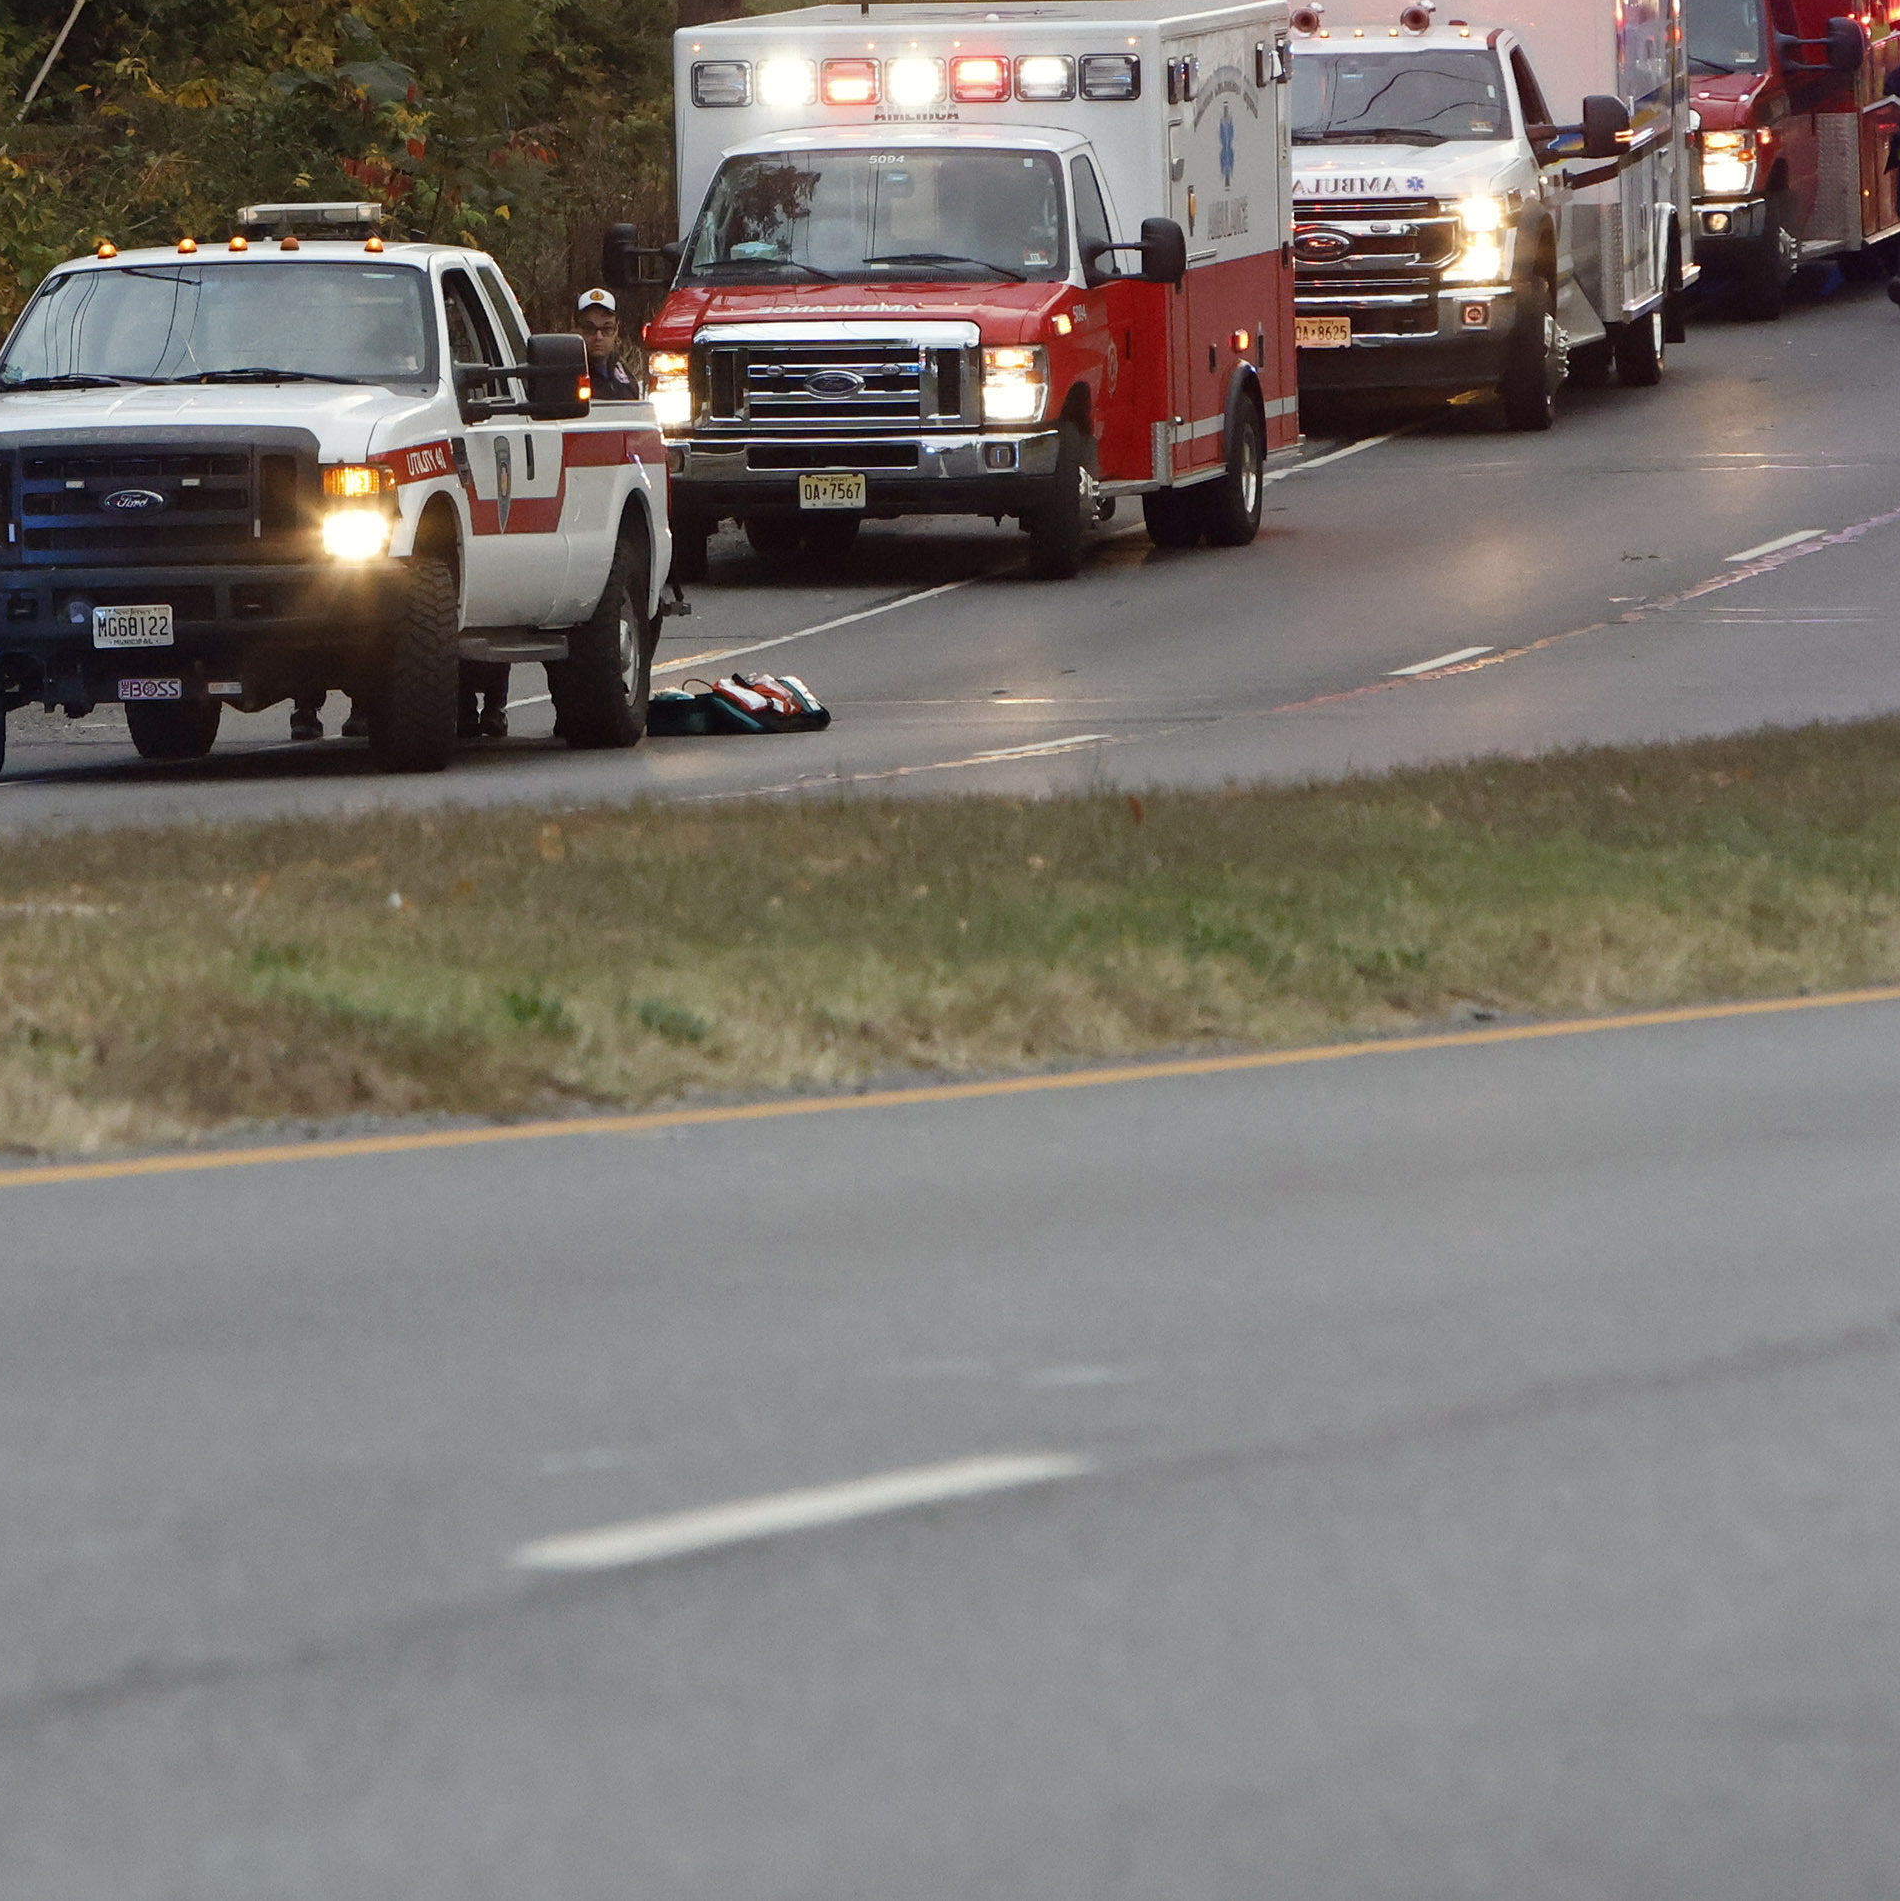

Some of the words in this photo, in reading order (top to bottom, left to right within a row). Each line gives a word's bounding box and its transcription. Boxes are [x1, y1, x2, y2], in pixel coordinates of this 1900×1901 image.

[868, 154, 905, 164] 5094
[1318, 325, 1348, 341] 8625
[406, 449, 436, 476] UTILITY
[829, 483, 861, 499] 7567
[97, 616, 169, 638] MG68122
[129, 680, 179, 698] BOSS
